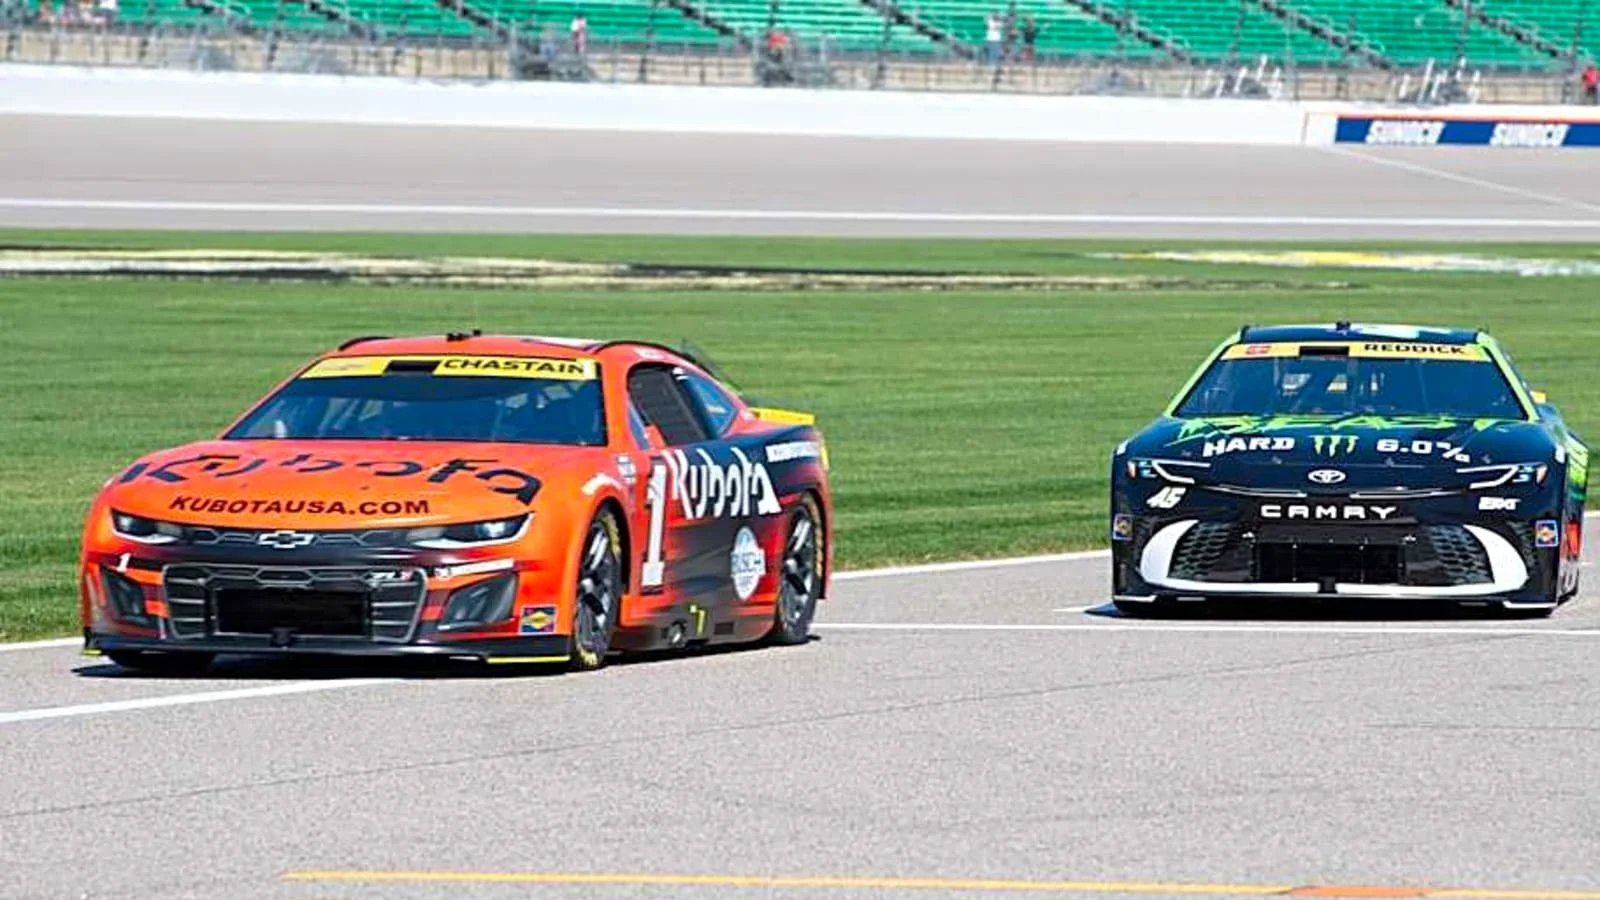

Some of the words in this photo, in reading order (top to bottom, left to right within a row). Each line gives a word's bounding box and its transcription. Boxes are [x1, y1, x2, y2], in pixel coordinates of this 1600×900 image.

[1363, 342, 1466, 355] REDDICK
[443, 359, 585, 374] CHASTAIN
[1202, 436, 1296, 458] HARD
[1376, 438, 1471, 463] 6.0%
[660, 446, 783, 521] Kubota
[168, 495, 430, 516] KUBOTAUSA.COM
[1145, 486, 1187, 509] 45
[1260, 504, 1398, 520] CAMRY
[641, 463, 667, 589] 1
[115, 552, 131, 573] 1
